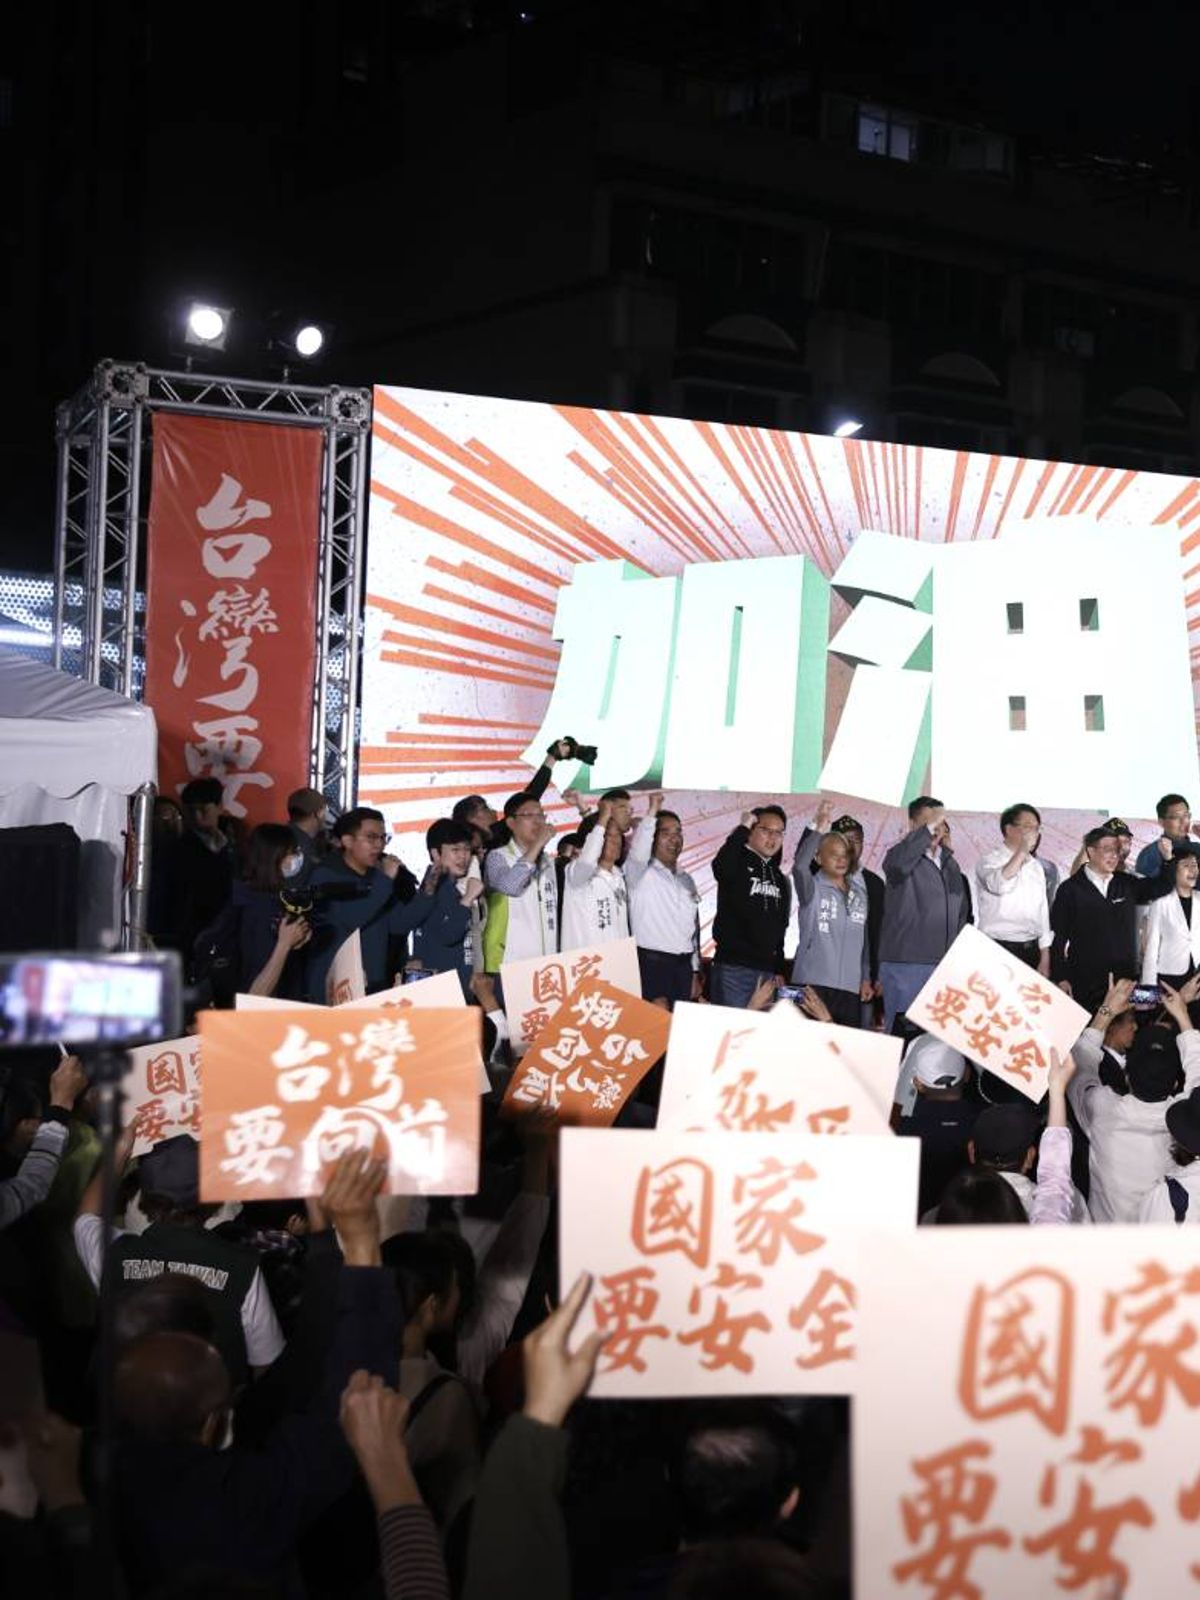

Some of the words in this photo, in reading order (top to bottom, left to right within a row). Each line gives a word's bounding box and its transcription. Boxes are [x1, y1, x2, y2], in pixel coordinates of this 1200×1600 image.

[173, 473, 280, 818] 台灣要
[271, 1018, 417, 1112] 台灣
[567, 1033, 650, 1109] 台灣
[926, 985, 1047, 1083] 要安全
[219, 1097, 449, 1188] 要向前
[631, 1156, 827, 1270] 國家
[122, 1259, 165, 1280] TEAM
[592, 1263, 857, 1375] 要安全
